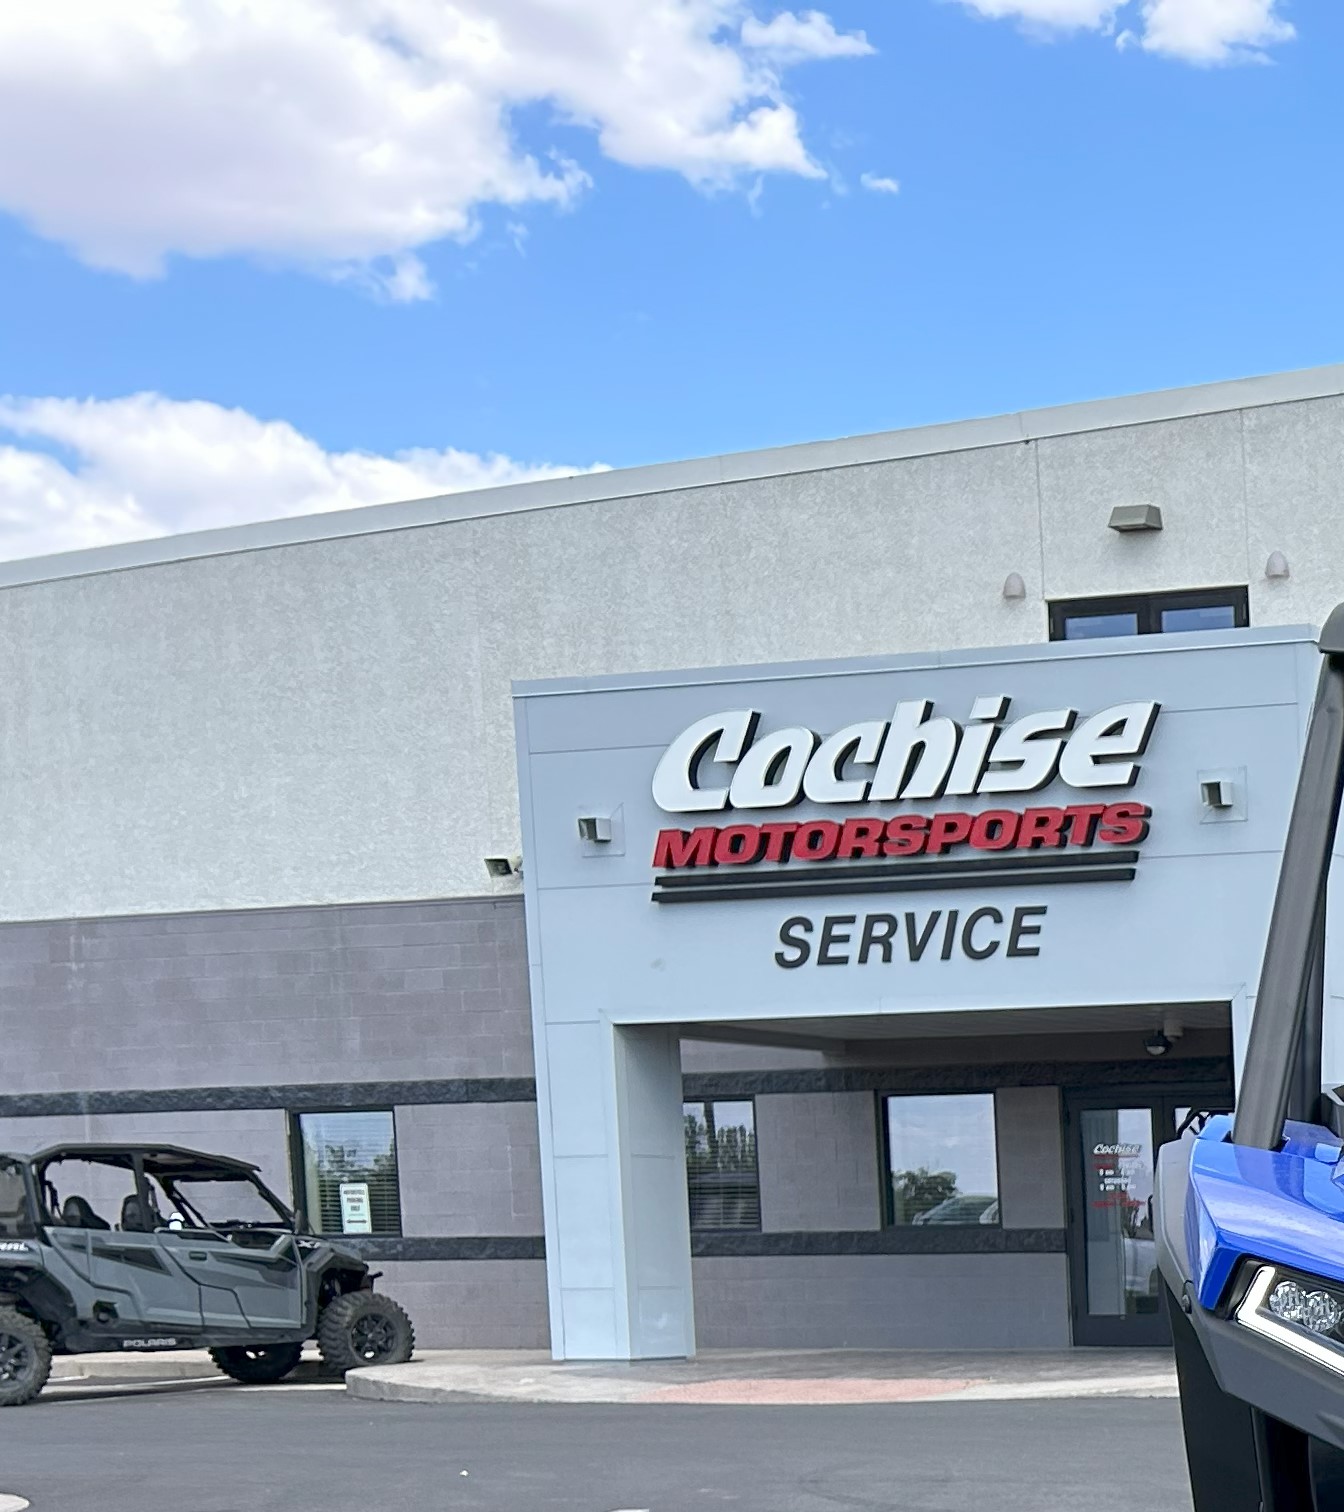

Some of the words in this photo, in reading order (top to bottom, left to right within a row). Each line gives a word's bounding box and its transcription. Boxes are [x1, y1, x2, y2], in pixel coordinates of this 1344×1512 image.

[652, 695, 1163, 813] Cochise
[652, 801, 1151, 868] MOTORSPORTS
[774, 905, 1048, 969] SERVICE
